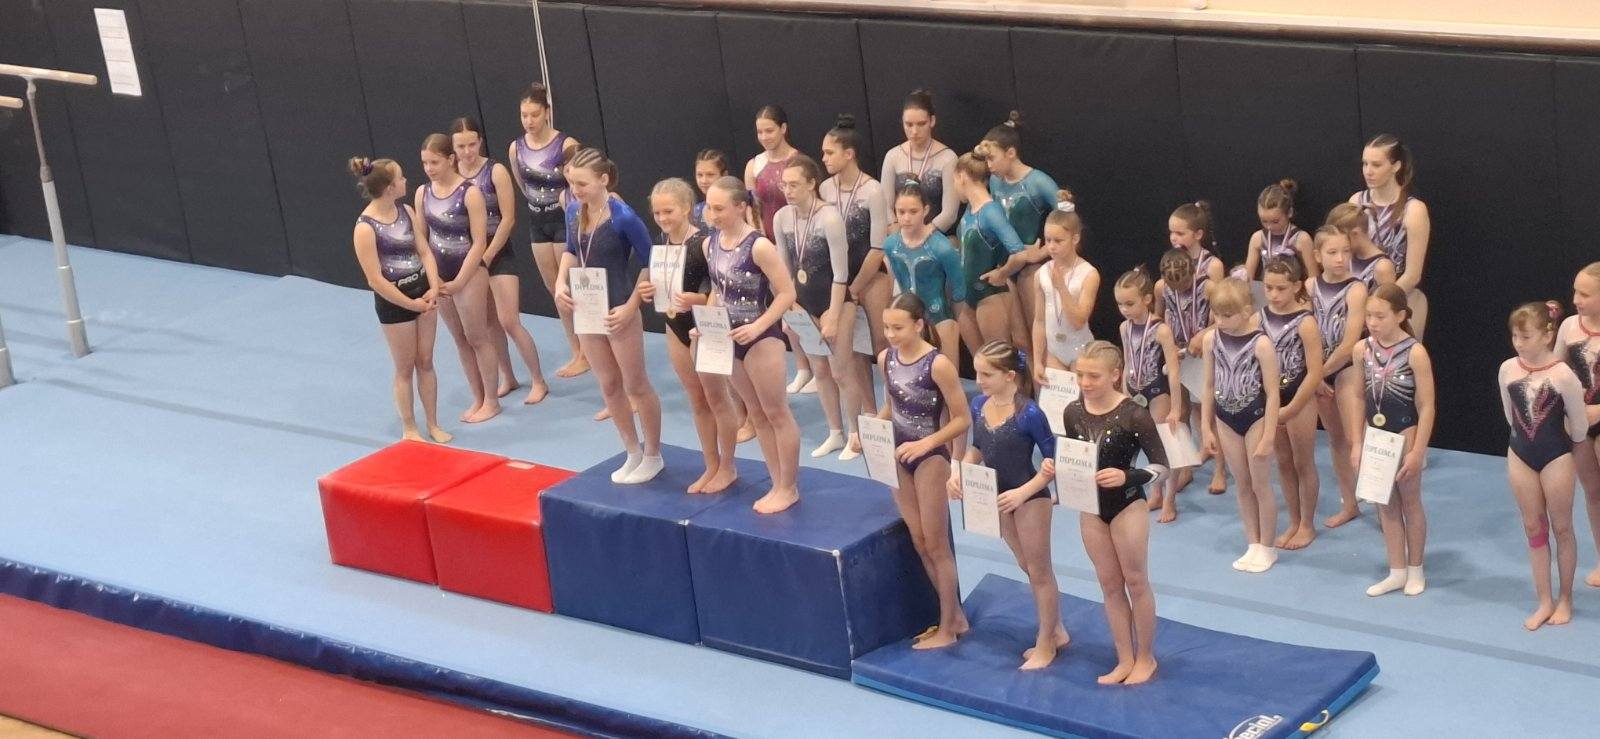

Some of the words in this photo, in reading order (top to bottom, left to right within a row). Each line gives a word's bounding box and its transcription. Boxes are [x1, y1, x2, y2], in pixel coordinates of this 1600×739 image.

[398, 273, 419, 287] PRO
[700, 320, 728, 330] DIPLOMA
[862, 433, 892, 445] DIPLOMA
[1365, 443, 1396, 458] DIPLOMA
[1059, 455, 1093, 468] DIPLOMA
[965, 480, 994, 492] DIPLOMA
